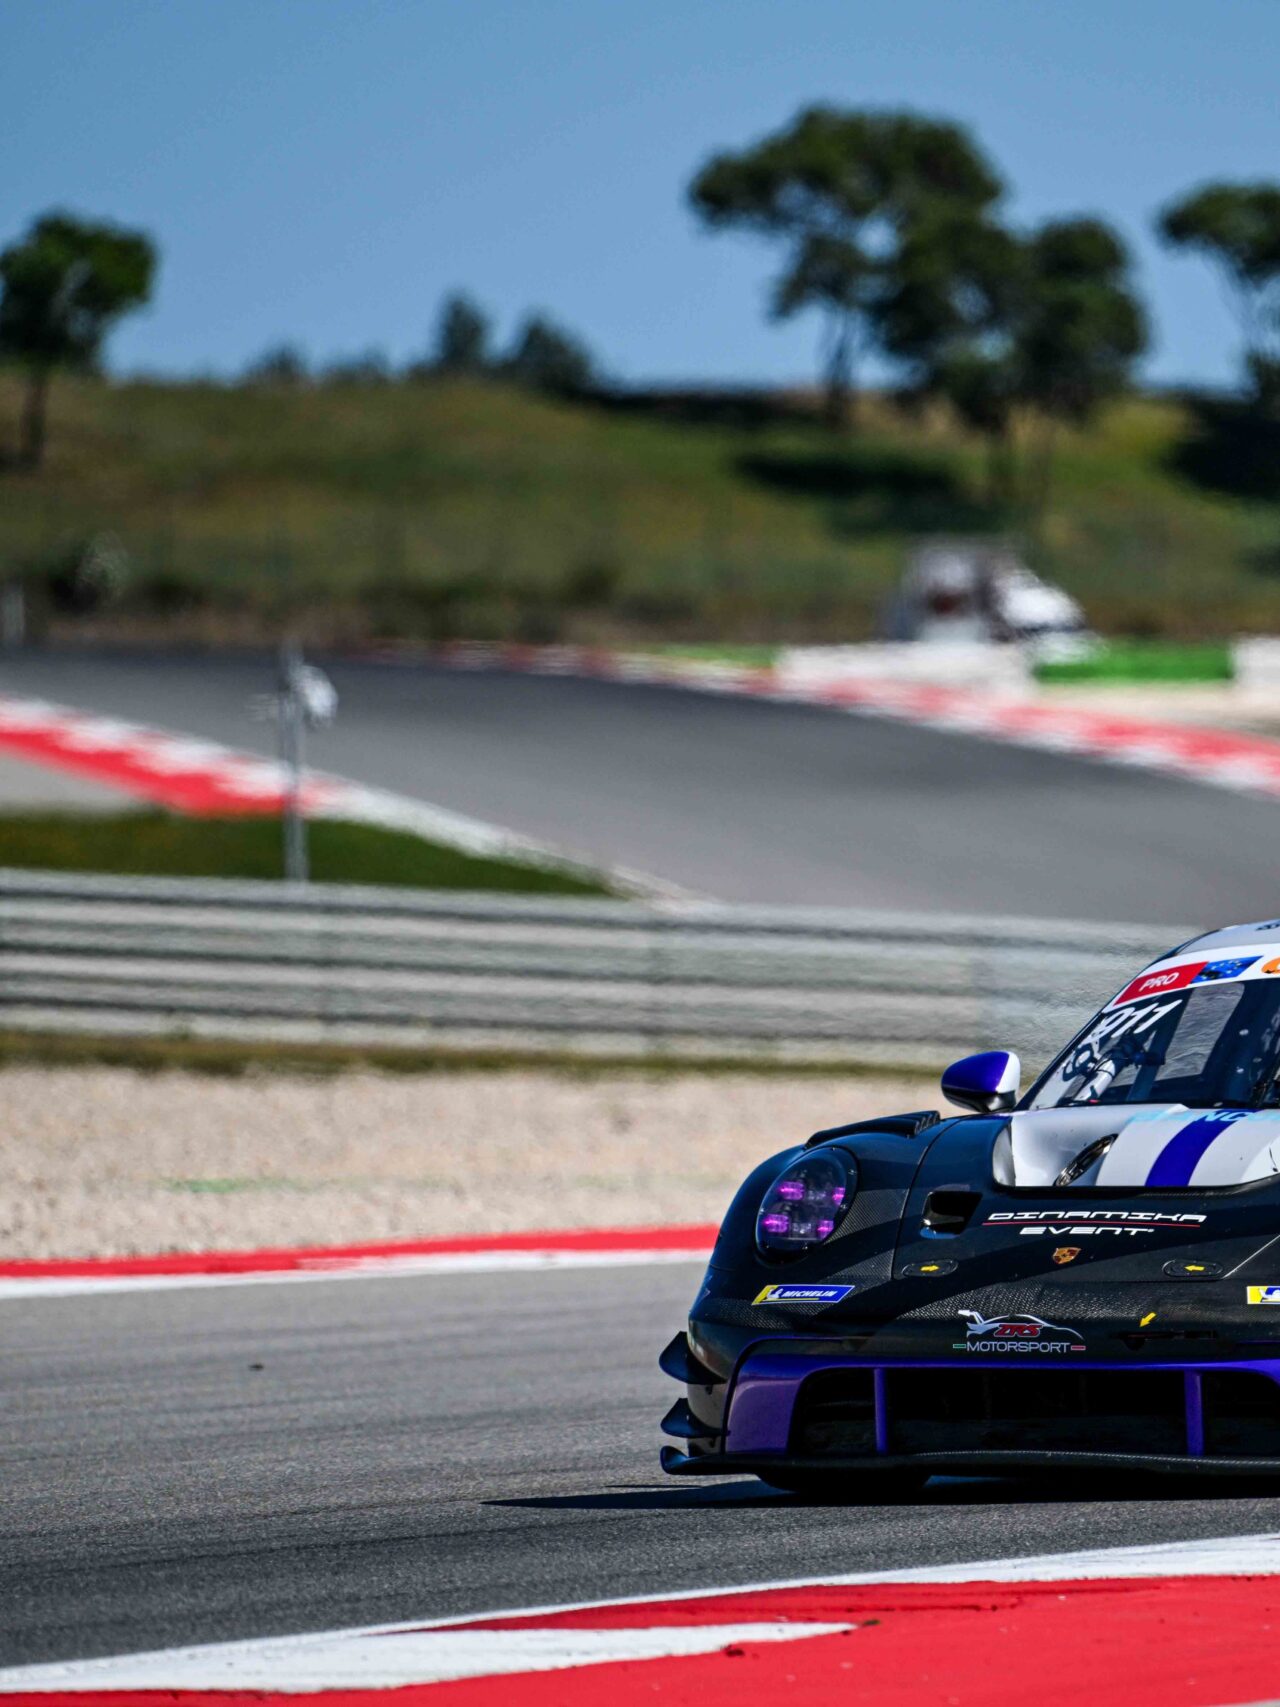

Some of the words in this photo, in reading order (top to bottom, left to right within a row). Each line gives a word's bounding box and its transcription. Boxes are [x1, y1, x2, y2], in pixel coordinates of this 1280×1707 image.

[1138, 972, 1180, 993] PRO
[988, 1211, 1207, 1223] DINAMIKA
[1019, 1226, 1151, 1236] EVENT
[781, 1290, 838, 1298] MICHELIN
[966, 1341, 1071, 1353] MOTORSPORT
